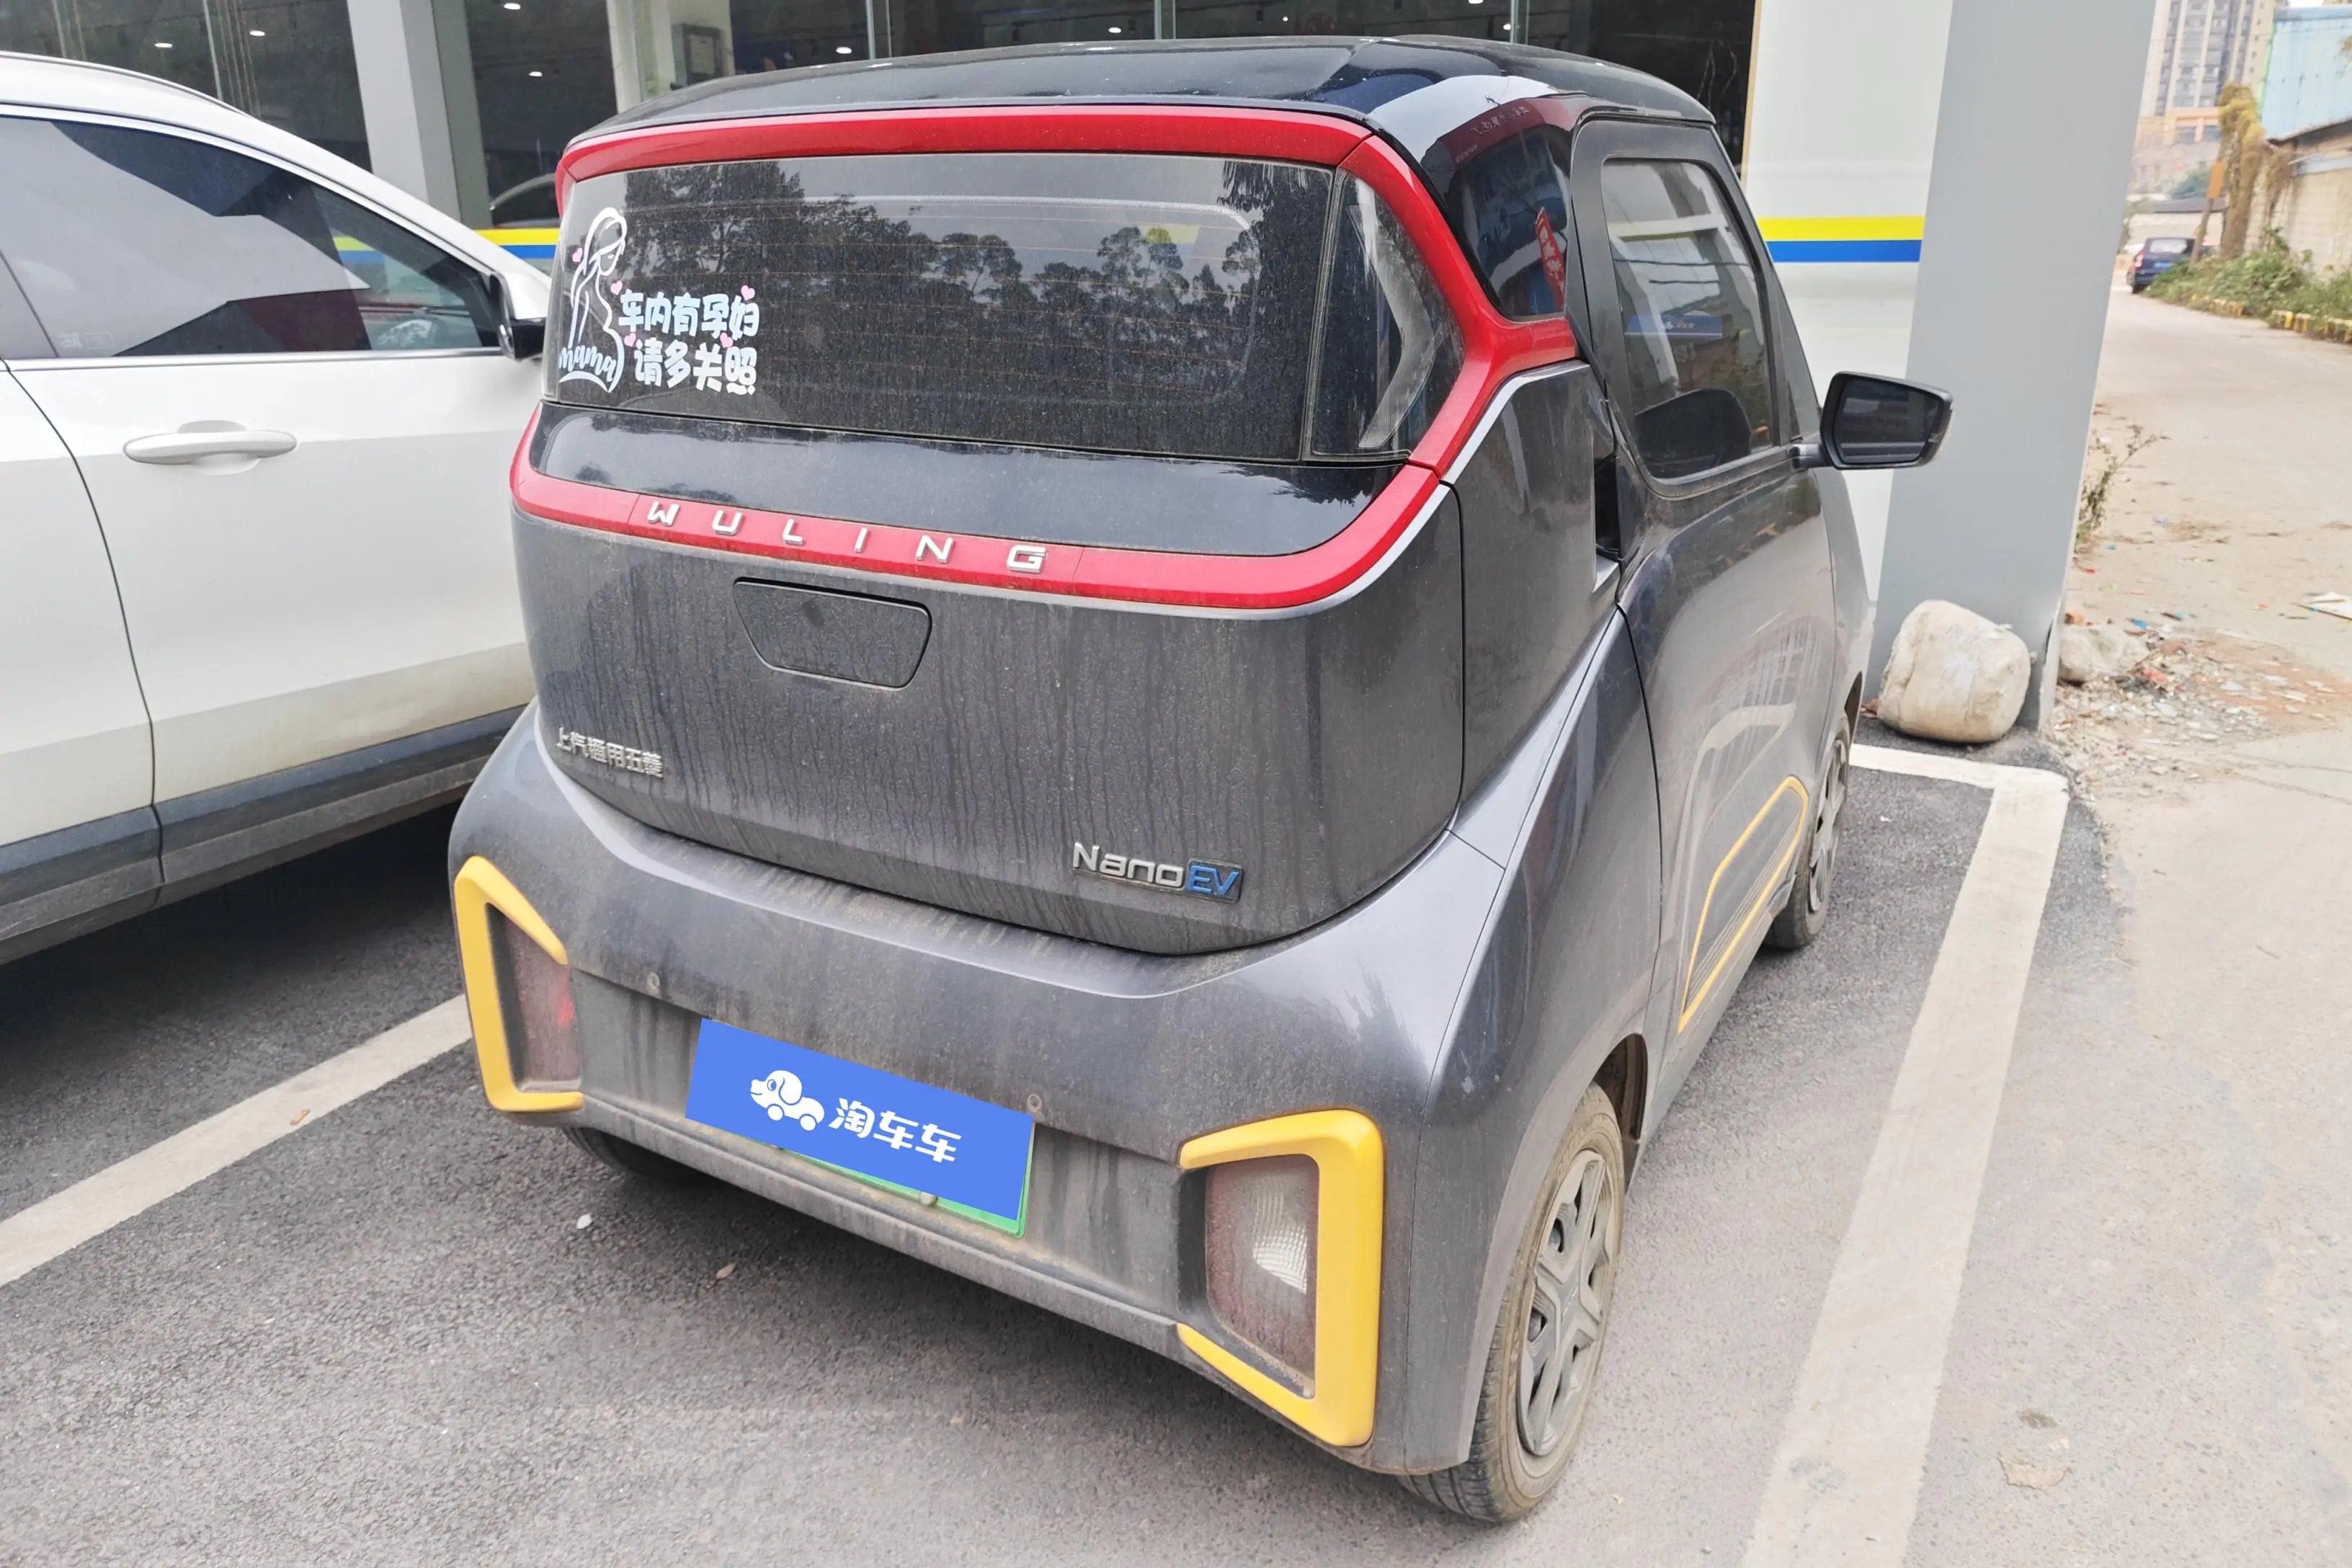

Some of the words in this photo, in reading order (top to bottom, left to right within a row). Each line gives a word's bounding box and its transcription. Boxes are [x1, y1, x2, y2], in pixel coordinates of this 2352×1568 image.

[618, 289, 760, 341] 车内有孕妇
[558, 344, 617, 382] mama
[634, 337, 757, 396] 请多关照
[647, 501, 1047, 574] WULING
[556, 726, 664, 778] 上汽通用五菱
